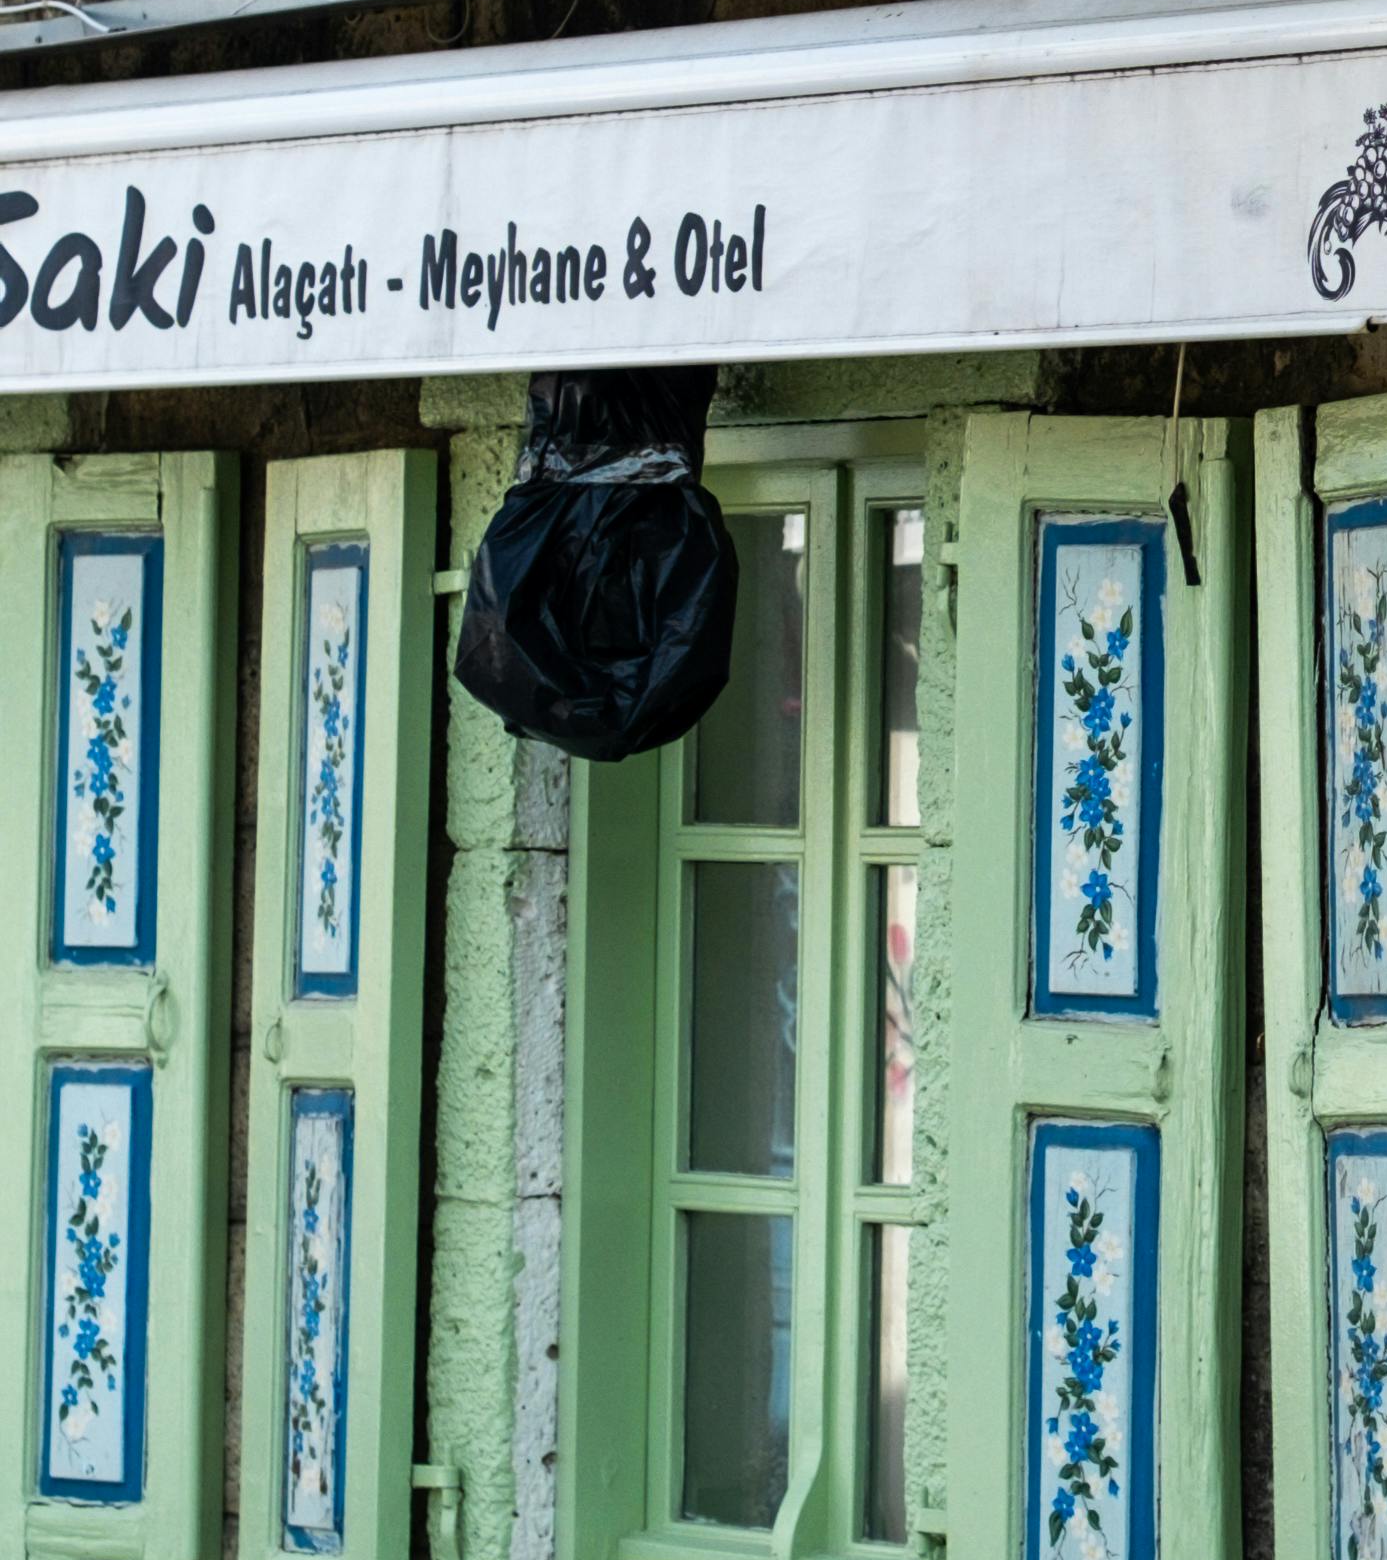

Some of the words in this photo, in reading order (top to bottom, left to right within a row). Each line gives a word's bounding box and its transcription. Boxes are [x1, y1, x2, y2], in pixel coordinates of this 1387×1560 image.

[229, 237, 367, 340] Alaçatı
[419, 221, 608, 332] Meyhane
[624, 216, 656, 299] &
[674, 203, 766, 297] Otel
